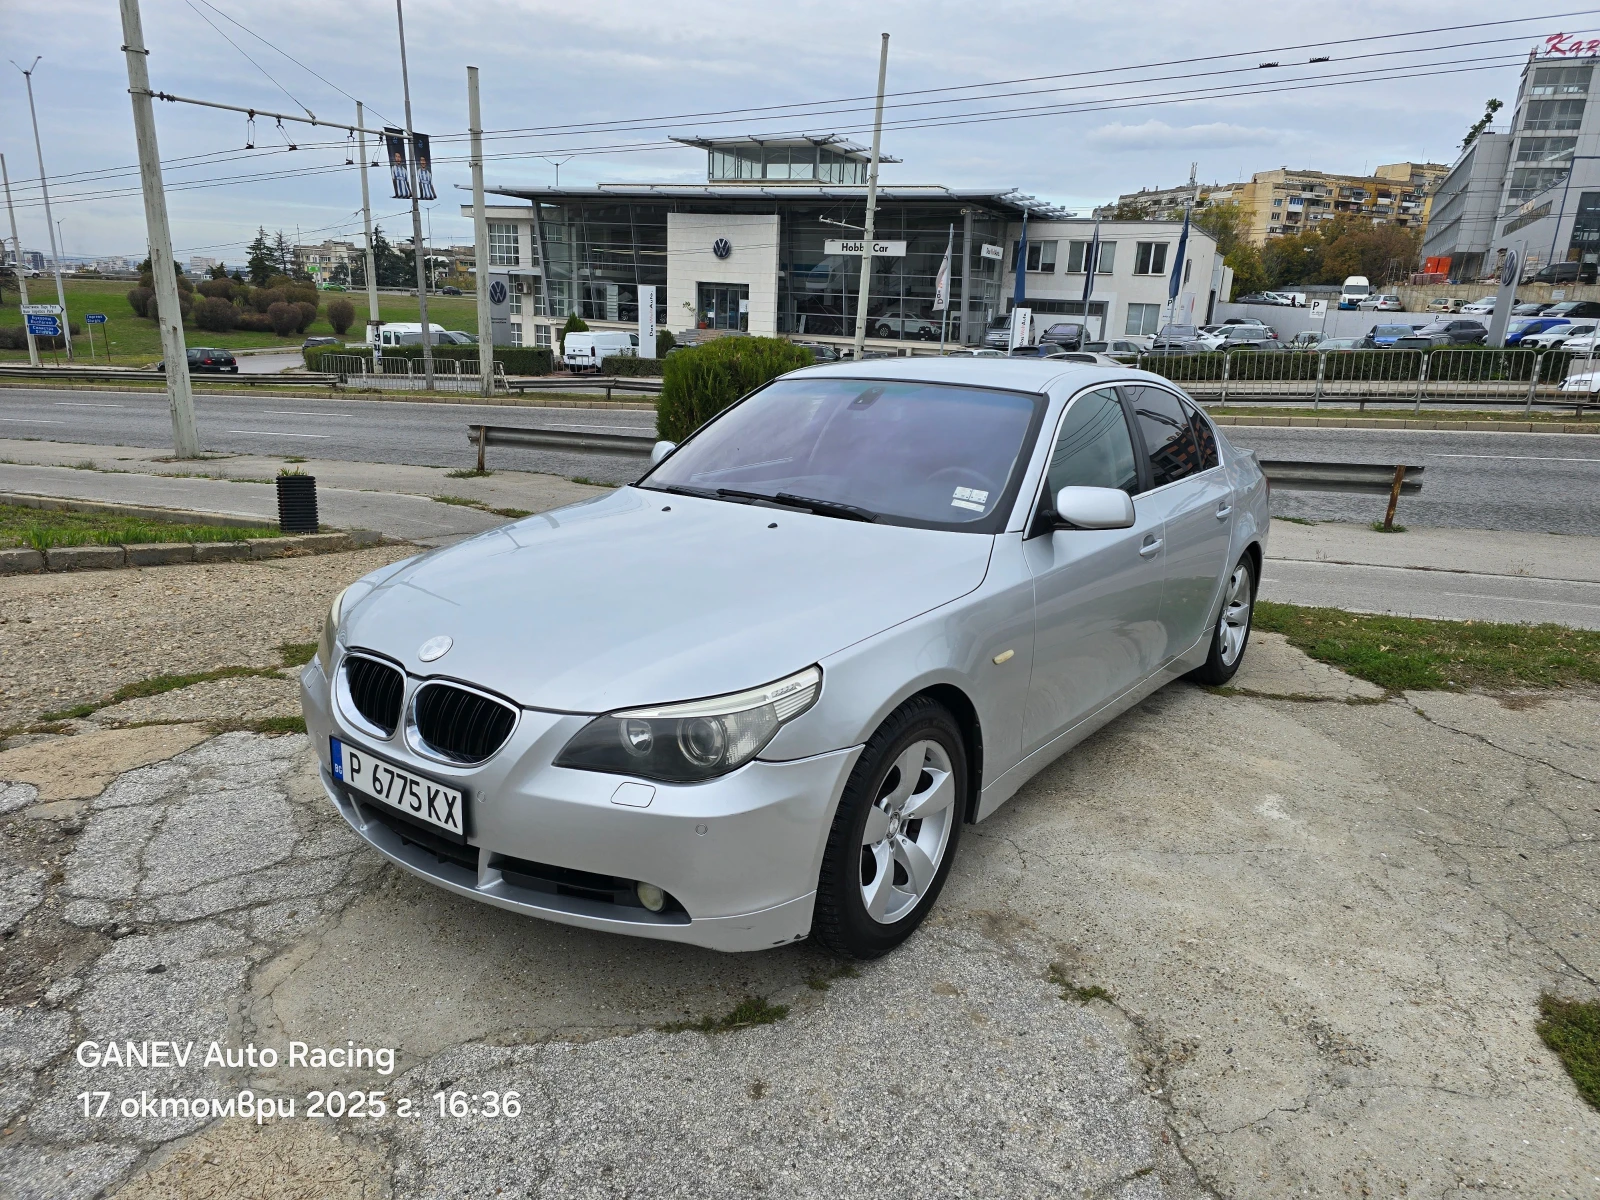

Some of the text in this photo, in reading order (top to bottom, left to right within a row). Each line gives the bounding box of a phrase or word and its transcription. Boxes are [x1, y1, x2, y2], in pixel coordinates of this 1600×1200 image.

[841, 242, 889, 252] Hobb Car
[1312, 301, 1320, 311] P
[334, 763, 342, 775] BG
[349, 751, 458, 829] P 6775 KX
